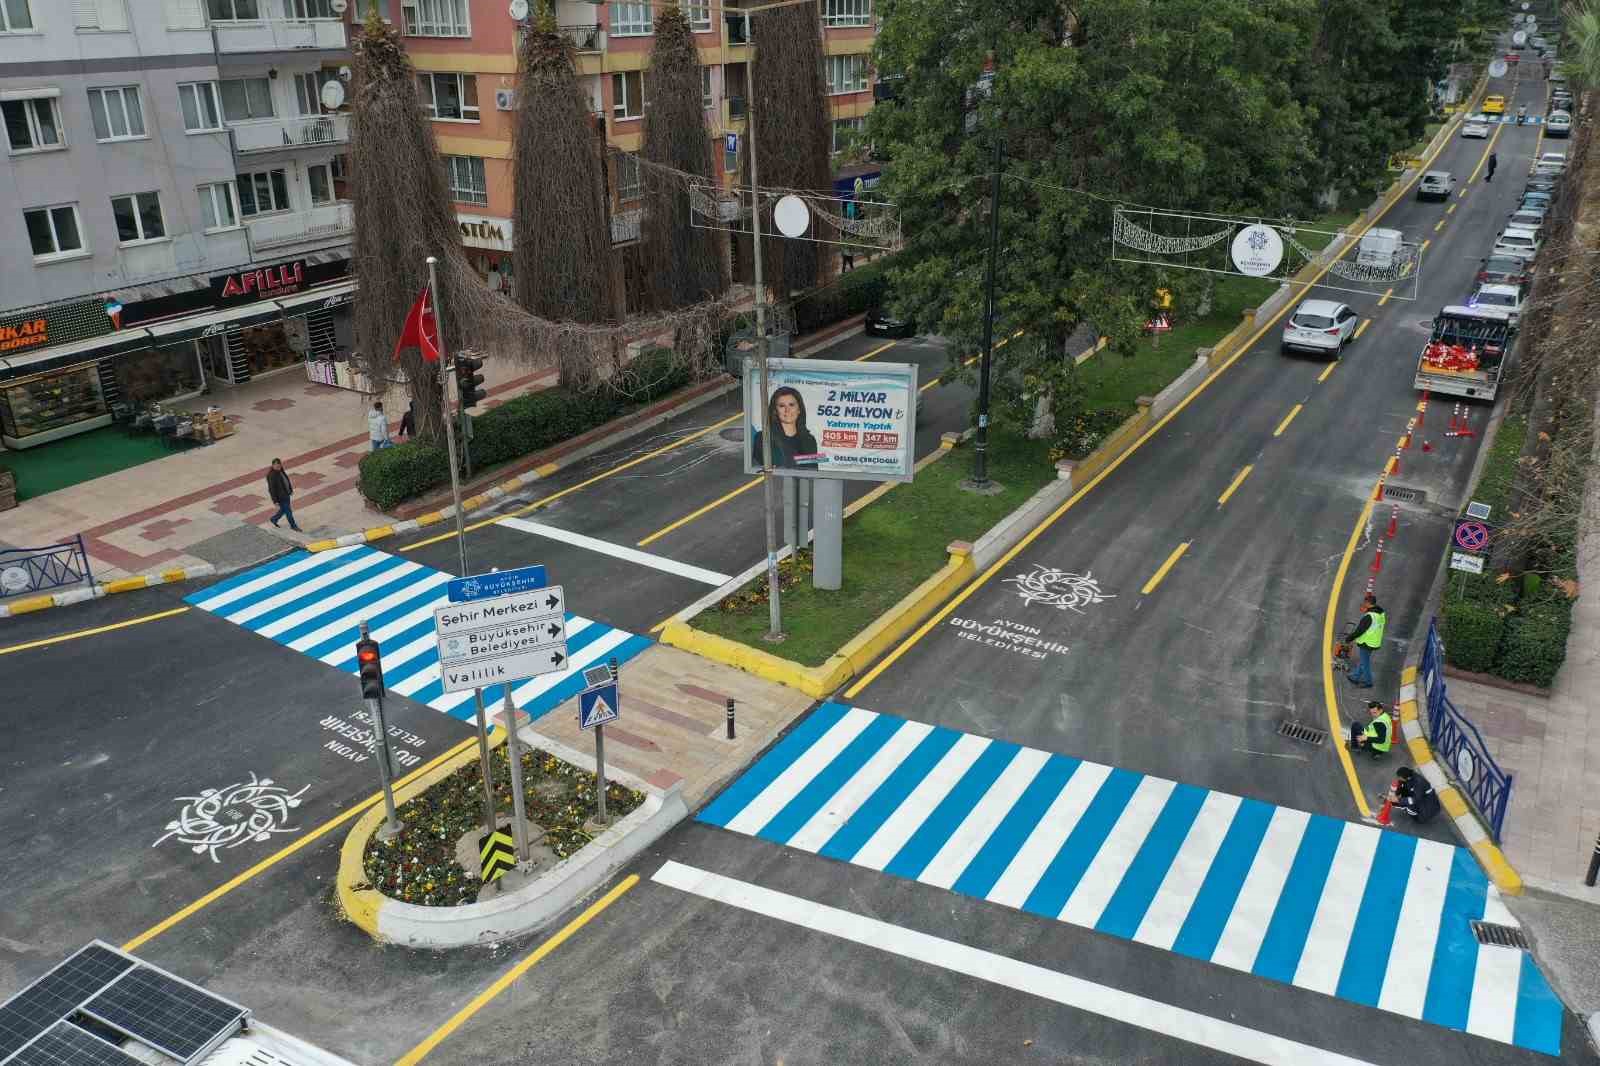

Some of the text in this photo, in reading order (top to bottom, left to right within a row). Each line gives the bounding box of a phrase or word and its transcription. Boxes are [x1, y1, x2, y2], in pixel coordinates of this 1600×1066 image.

[459, 220, 505, 241] STÜM
[827, 390, 836, 402] 2
[817, 405, 841, 417] 562
[844, 431, 857, 442] km
[883, 433, 897, 444] km
[441, 600, 538, 627] Şehir Merkezi
[469, 623, 545, 644] Büyükşehir
[993, 618, 1041, 635] AYDIN
[471, 636, 538, 655] Belediyesi
[449, 665, 505, 684] Valilik
[323, 740, 369, 762] AYDIN
